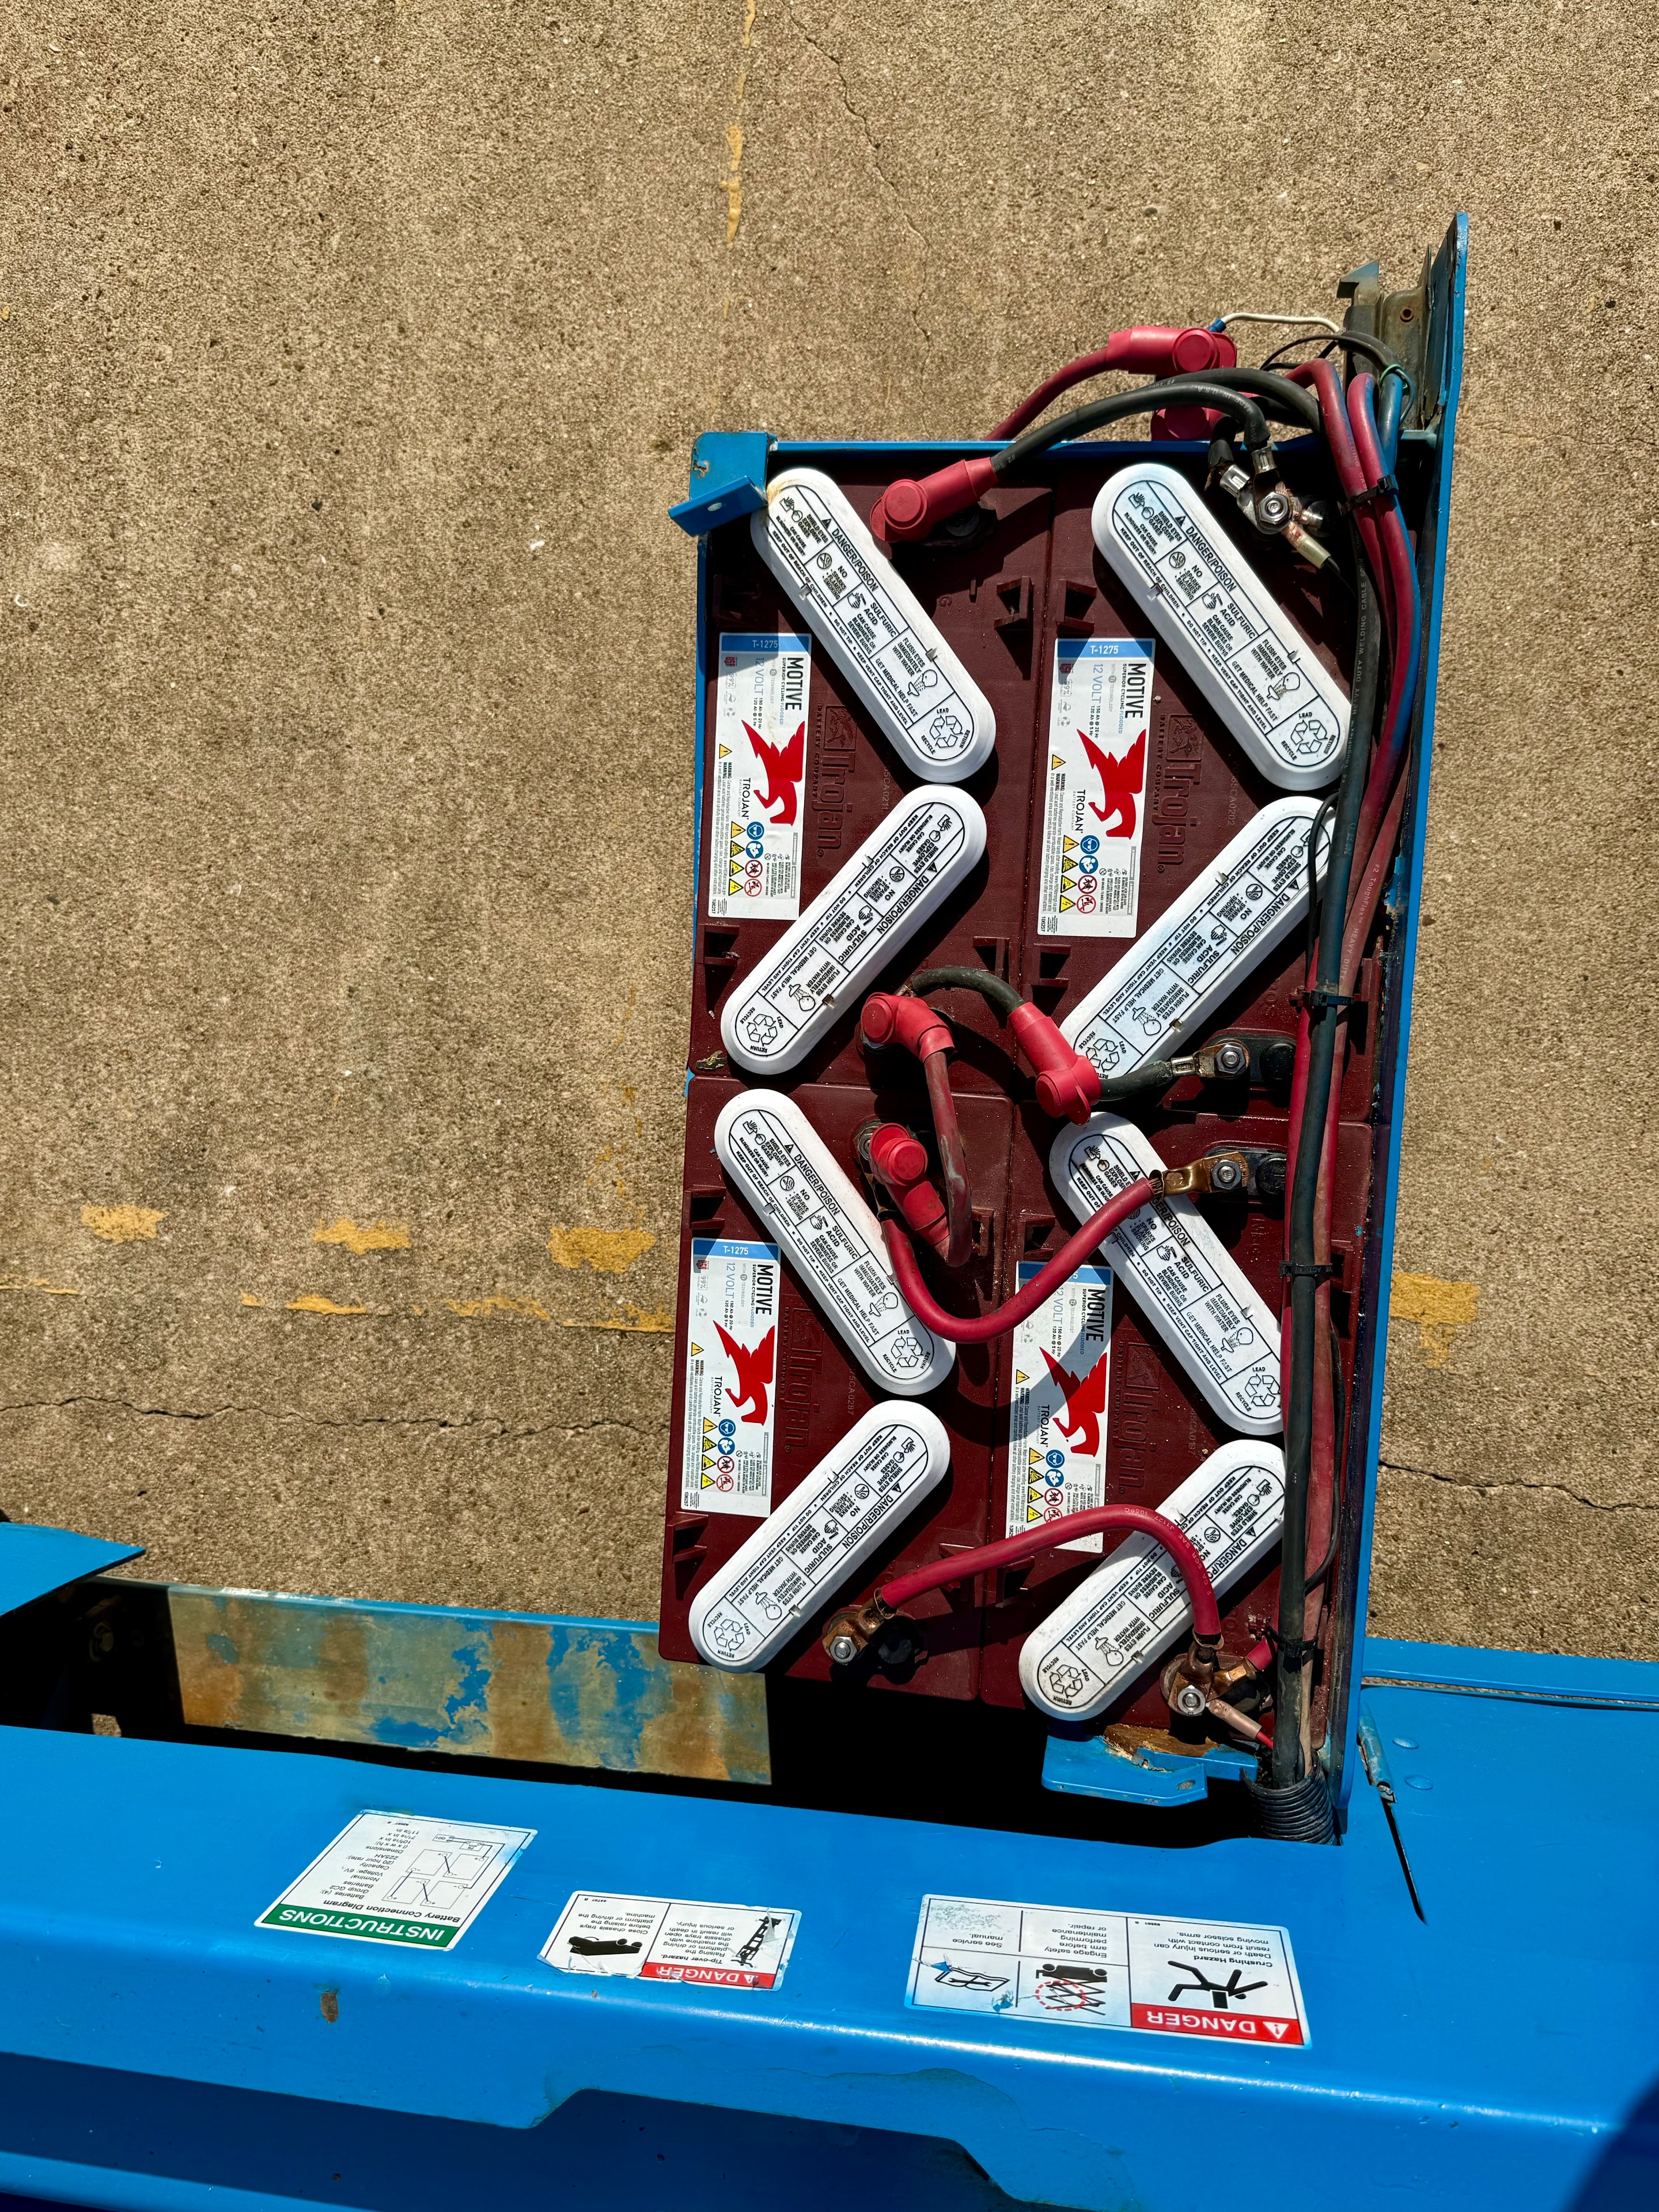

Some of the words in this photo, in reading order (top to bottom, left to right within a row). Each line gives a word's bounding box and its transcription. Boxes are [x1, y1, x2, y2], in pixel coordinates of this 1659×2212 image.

[830, 528, 878, 592] DANGER/POISON
[1184, 525, 1237, 592] DANGER/POISON
[869, 601, 897, 638] SULFURIC
[1226, 601, 1256, 639] SULFURIC
[752, 640, 779, 649] T-1275
[1089, 645, 1119, 654] T-1275
[1261, 638, 1278, 657] FLUSH
[1273, 654, 1287, 671] EYES
[755, 657, 764, 666] 12
[1092, 663, 1103, 673] 12
[1249, 647, 1263, 662] WITH
[1259, 660, 1276, 680] WATER
[1255, 643, 1283, 677] IMMEDIATELY
[1352, 688, 1360, 715] HEAVY
[1359, 615, 1367, 654] WELDING
[753, 669, 764, 695] VOLT
[784, 657, 804, 711] MOTIVE
[1090, 675, 1103, 703] VOLT
[1124, 663, 1146, 719] MOTIVE
[1230, 660, 1243, 673] GET
[1238, 671, 1259, 695] MEDICAL
[1255, 692, 1269, 709] HELP
[1265, 706, 1279, 722] FAST
[920, 734, 936, 755] RECYCLE
[1280, 740, 1298, 761] RECYCLE
[741, 777, 751, 819] TROJAN
[811, 751, 856, 850] Trojan
[1074, 789, 1086, 832] TROJAN
[1152, 763, 1202, 865] Trojan
[875, 874, 929, 934] DANGER/POISON
[1229, 892, 1290, 955] DANGER/POISON
[837, 929, 868, 962] SULFURIC
[1348, 928, 1359, 955] HEAVY
[1186, 949, 1220, 984] SULFURIC
[1340, 959, 1350, 980] DUTY
[739, 1006, 756, 1025] RECYCLE
[1077, 1031, 1096, 1050] RECYCLE
[793, 1153, 840, 1216] DANGER/POISON
[1151, 1197, 1190, 1247] GER/POISON
[722, 1245, 749, 1255] T-1275
[831, 1224, 858, 1260] SULFURIC
[726, 1262, 736, 1271] 12
[1180, 1255, 1210, 1293] SULFURIC
[725, 1273, 735, 1299] VOLT
[755, 1264, 774, 1315] MOTIVE
[1052, 1298, 1063, 1325] VOLT
[1085, 1288, 1105, 1342] MOTIVE
[881, 1353, 897, 1373] RECYCLE
[712, 1375, 722, 1415] TROJAN
[1234, 1391, 1252, 1412] RECYCLE
[1039, 1404, 1050, 1446] TROJAN
[841, 1493, 893, 1550] DANGER/POISON
[803, 1542, 833, 1574] SULFURIC
[1205, 1537, 1247, 1579] DANGER/PO
[1147, 1587, 1180, 1619] SULFURIC
[706, 1611, 723, 1628] RECYCLE
[1041, 1656, 1059, 1674] RECYCLE
[365, 1845, 404, 1854] Dimensions
[359, 1862, 389, 1870] Capacity
[334, 1891, 365, 1899] Batteries
[343, 1880, 374, 1888] Batteries
[323, 1899, 364, 1910] Diagram
[366, 1905, 422, 1918] Connection
[424, 1912, 461, 1923] Battery
[279, 1909, 445, 1940] INSTRUCTIONS
[1051, 1928, 1106, 1937] maintenance
[1060, 1934, 1107, 1944] performing
[1172, 1944, 1196, 1952] injury
[1236, 1936, 1268, 1944] moving
[698, 1949, 725, 1957] Raising
[1073, 1949, 1107, 1958] Engage
[1193, 1955, 1226, 1963] Hazard
[1228, 1957, 1272, 1967] Crushing
[657, 1965, 740, 1982] DANGER
[1147, 2010, 1256, 2033] DANGER
